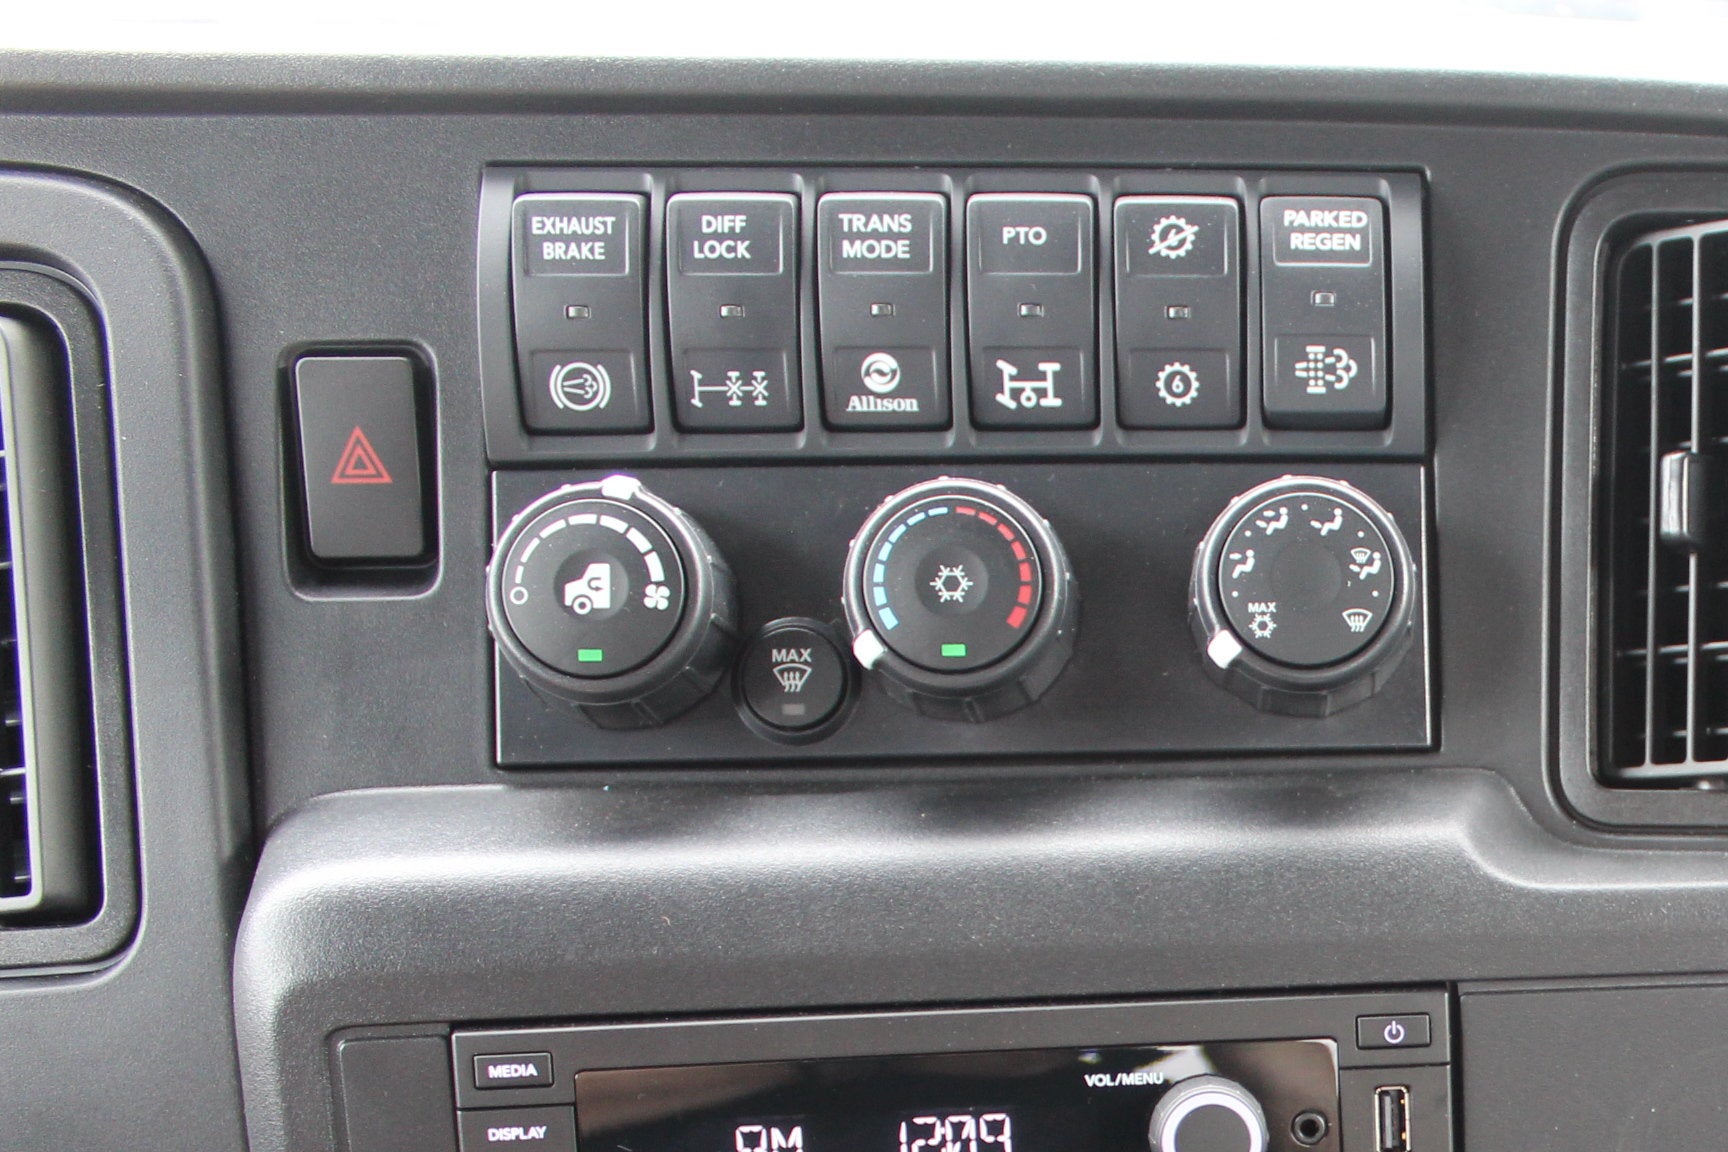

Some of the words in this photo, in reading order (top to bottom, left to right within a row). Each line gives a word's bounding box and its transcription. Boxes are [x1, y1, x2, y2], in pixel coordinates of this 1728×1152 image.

[532, 217, 615, 234] EXHAUST
[702, 215, 746, 233] DIFF
[839, 214, 911, 232] TRANS
[1284, 210, 1368, 227] PARKED
[1003, 227, 1046, 244] PTO
[1291, 233, 1360, 250] REGEN
[543, 242, 605, 259] BRAKE
[694, 240, 750, 258] LOCK
[843, 240, 910, 258] MODE
[847, 396, 918, 411] Allison
[1248, 602, 1276, 612] MAX
[772, 649, 811, 662] MAX
[488, 1064, 537, 1078] MEDIA
[1084, 1071, 1165, 1086] VOL/MENU
[488, 1126, 546, 1141] DISPLAY
